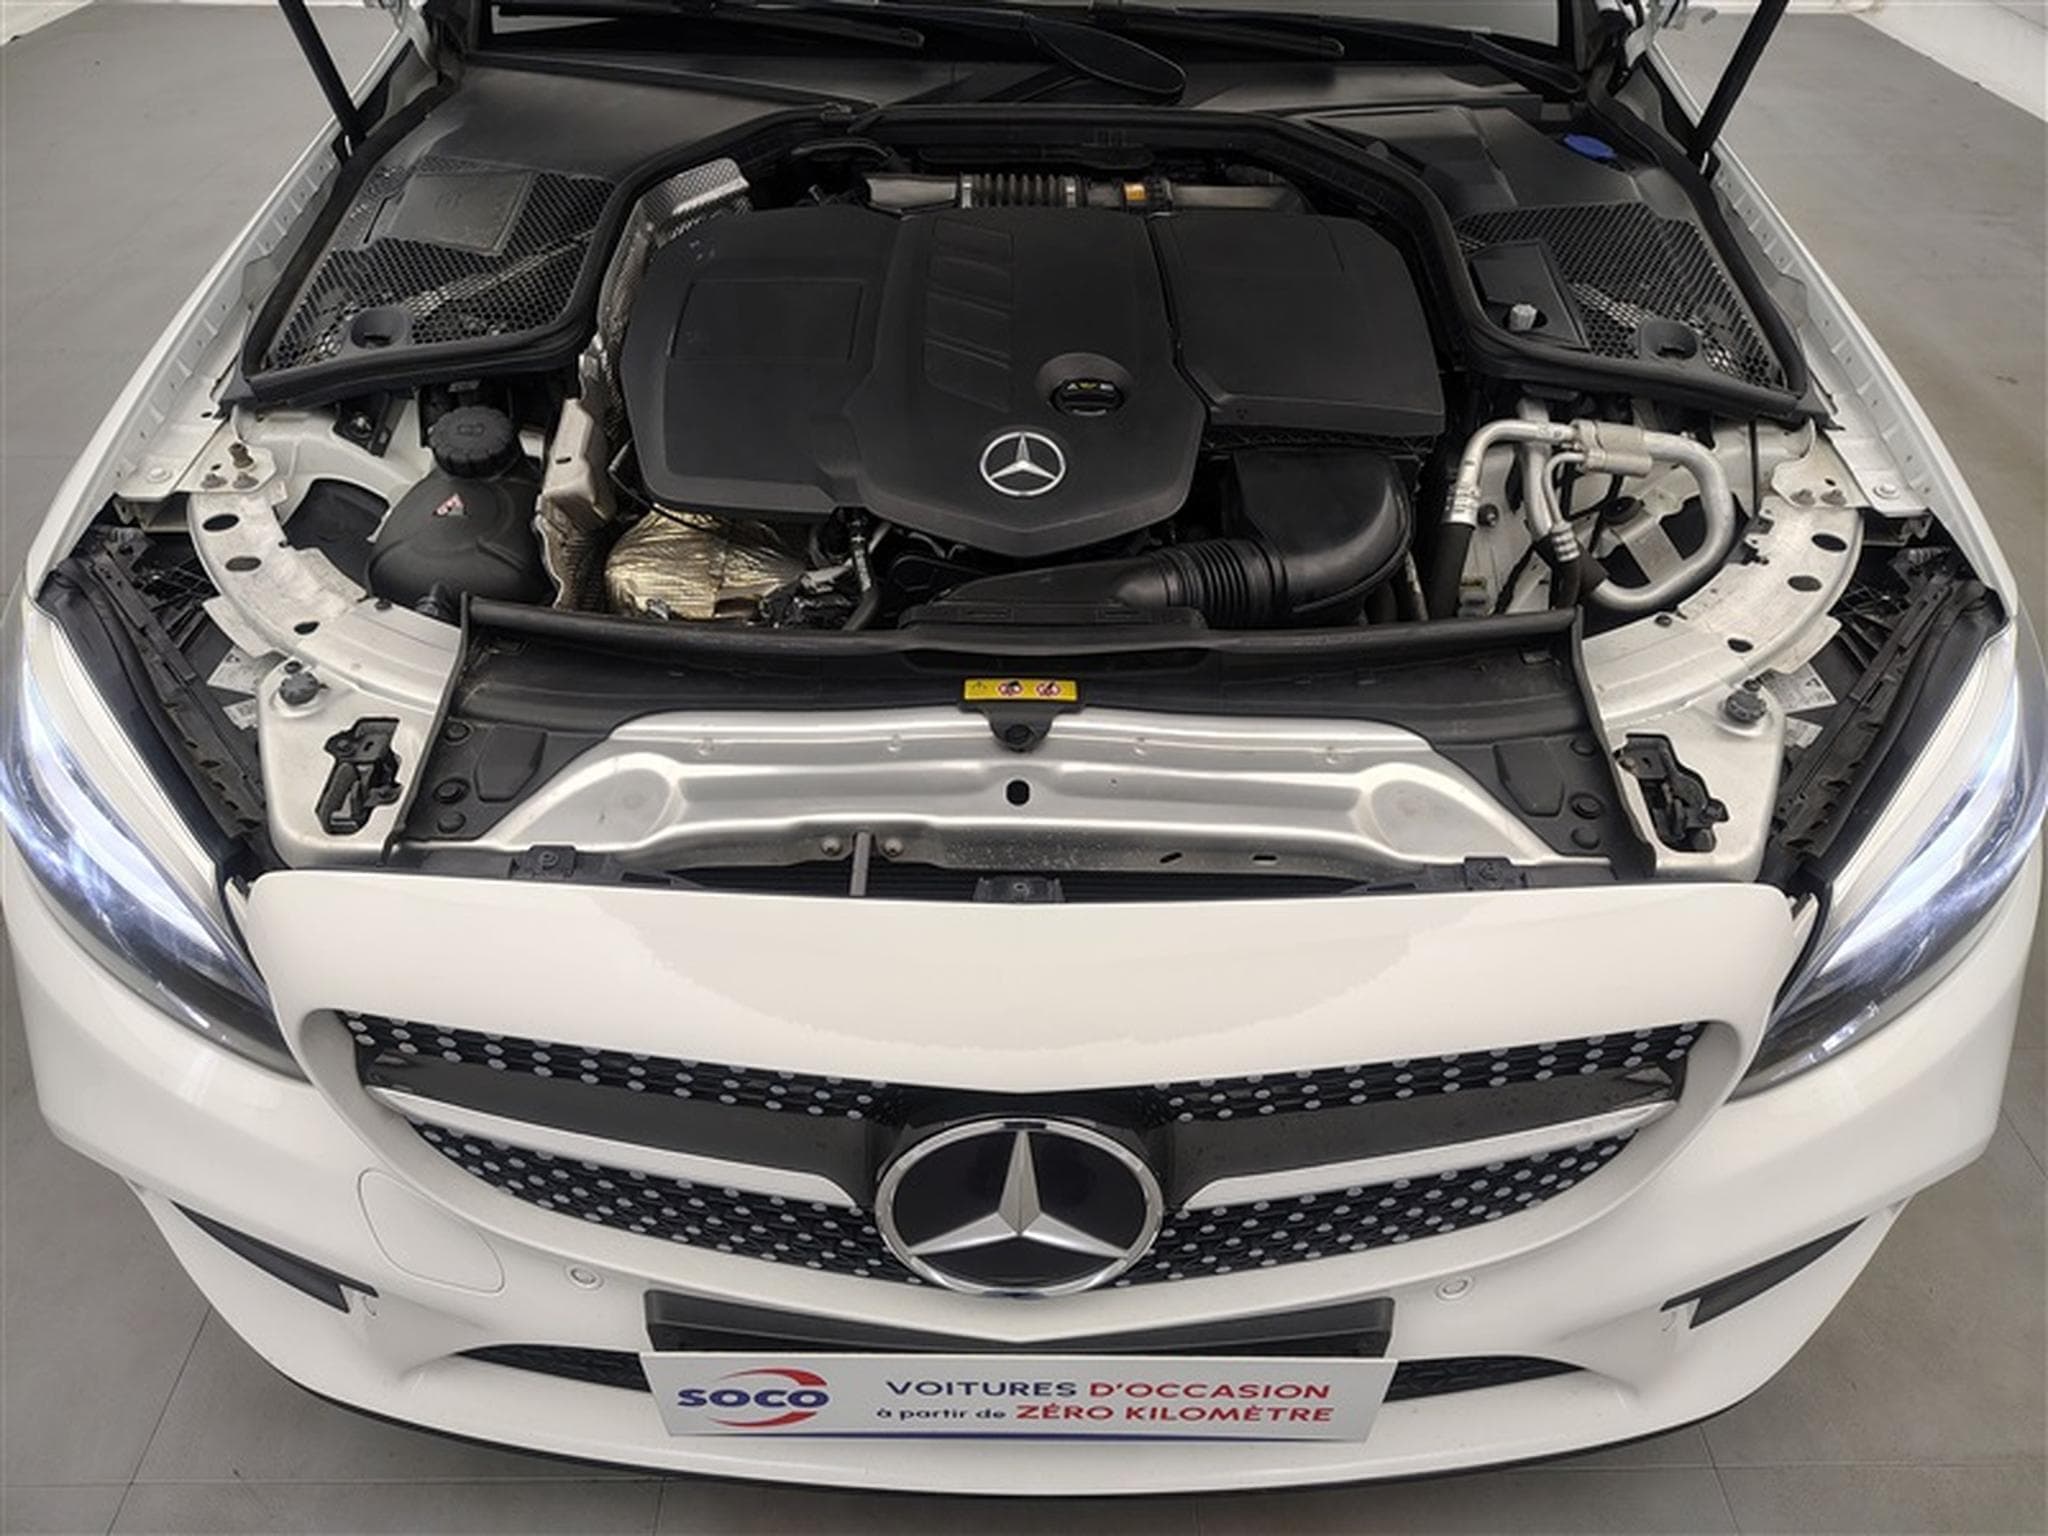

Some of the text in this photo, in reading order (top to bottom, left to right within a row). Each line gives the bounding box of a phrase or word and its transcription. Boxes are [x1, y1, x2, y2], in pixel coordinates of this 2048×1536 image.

[677, 1388, 829, 1408] SOCO
[886, 1381, 1330, 1398] VOITURES D'OCCASION
[876, 1402, 1334, 1421] à partir de ZÉRO KILOMÈTRE
